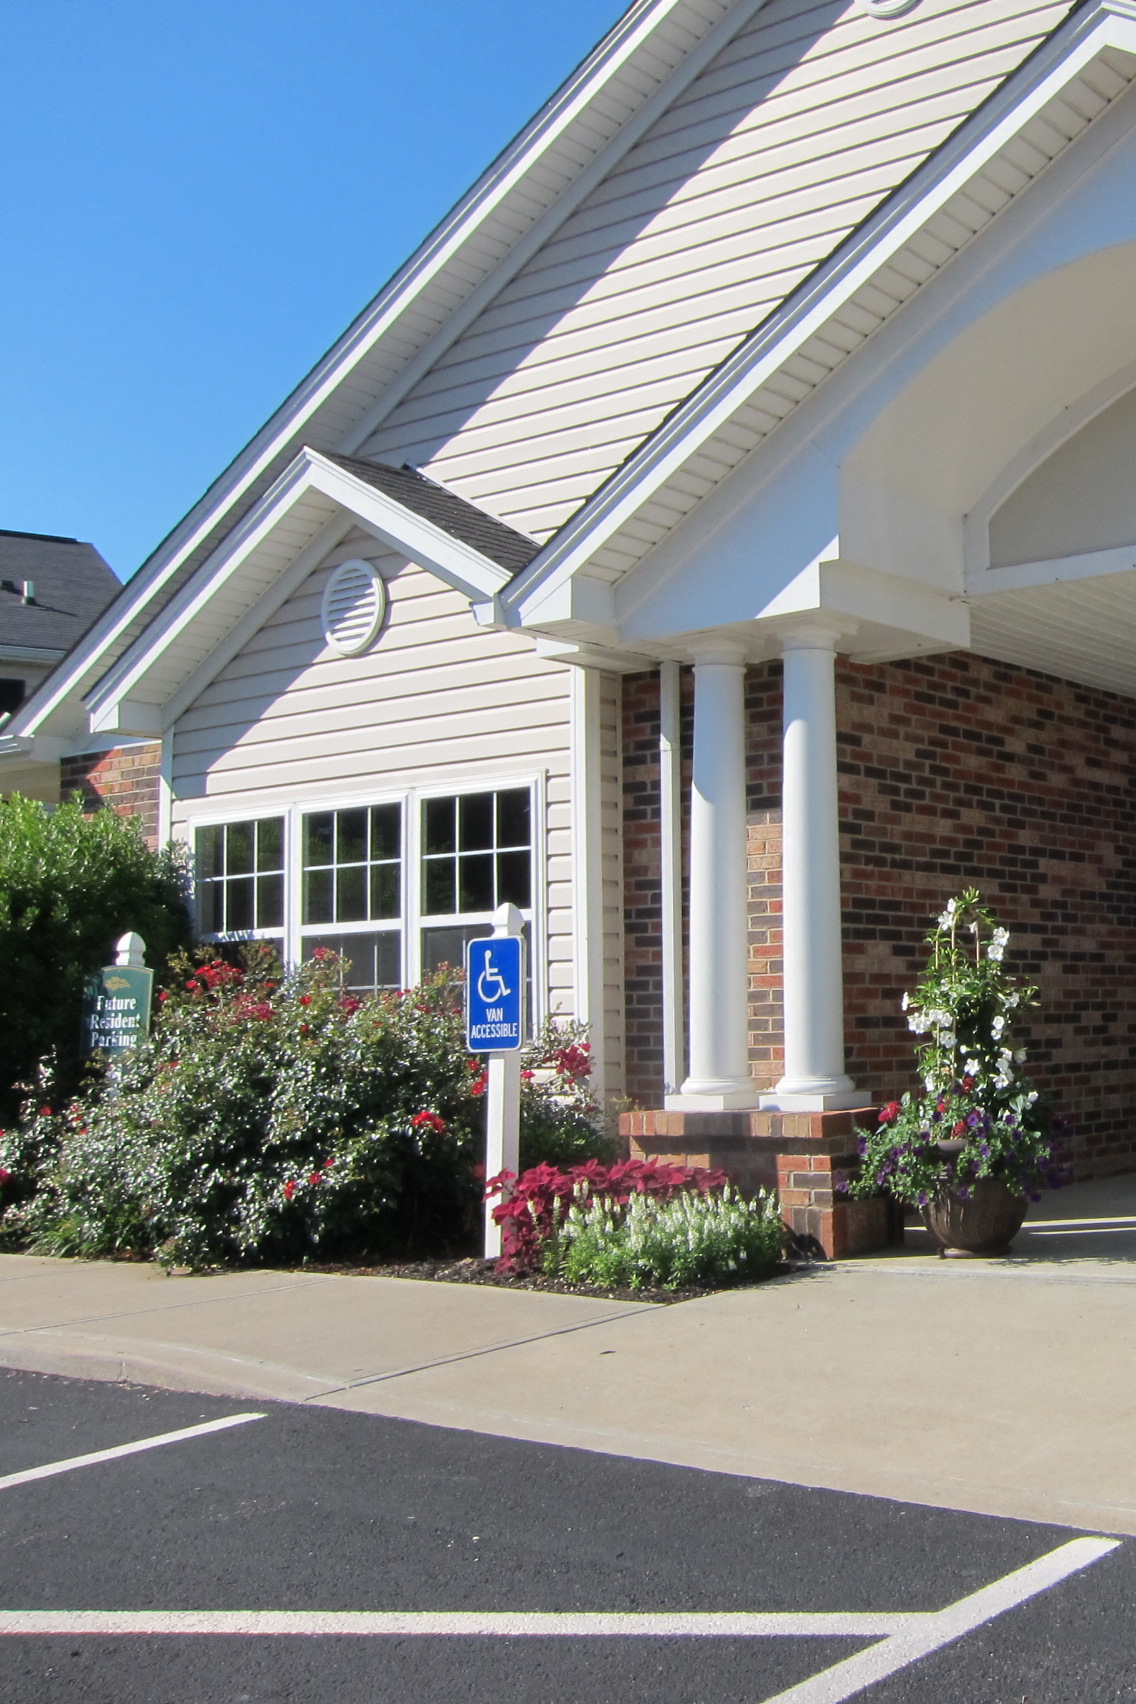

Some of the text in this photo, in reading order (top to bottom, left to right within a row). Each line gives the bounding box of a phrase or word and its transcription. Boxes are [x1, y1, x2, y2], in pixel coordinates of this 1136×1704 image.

[97, 995, 137, 1011] Future
[90, 1012, 141, 1029] Resident
[486, 1008, 504, 1022] VAN
[90, 1030, 138, 1048] Parking
[471, 1023, 518, 1039] ACCESSIBLE
